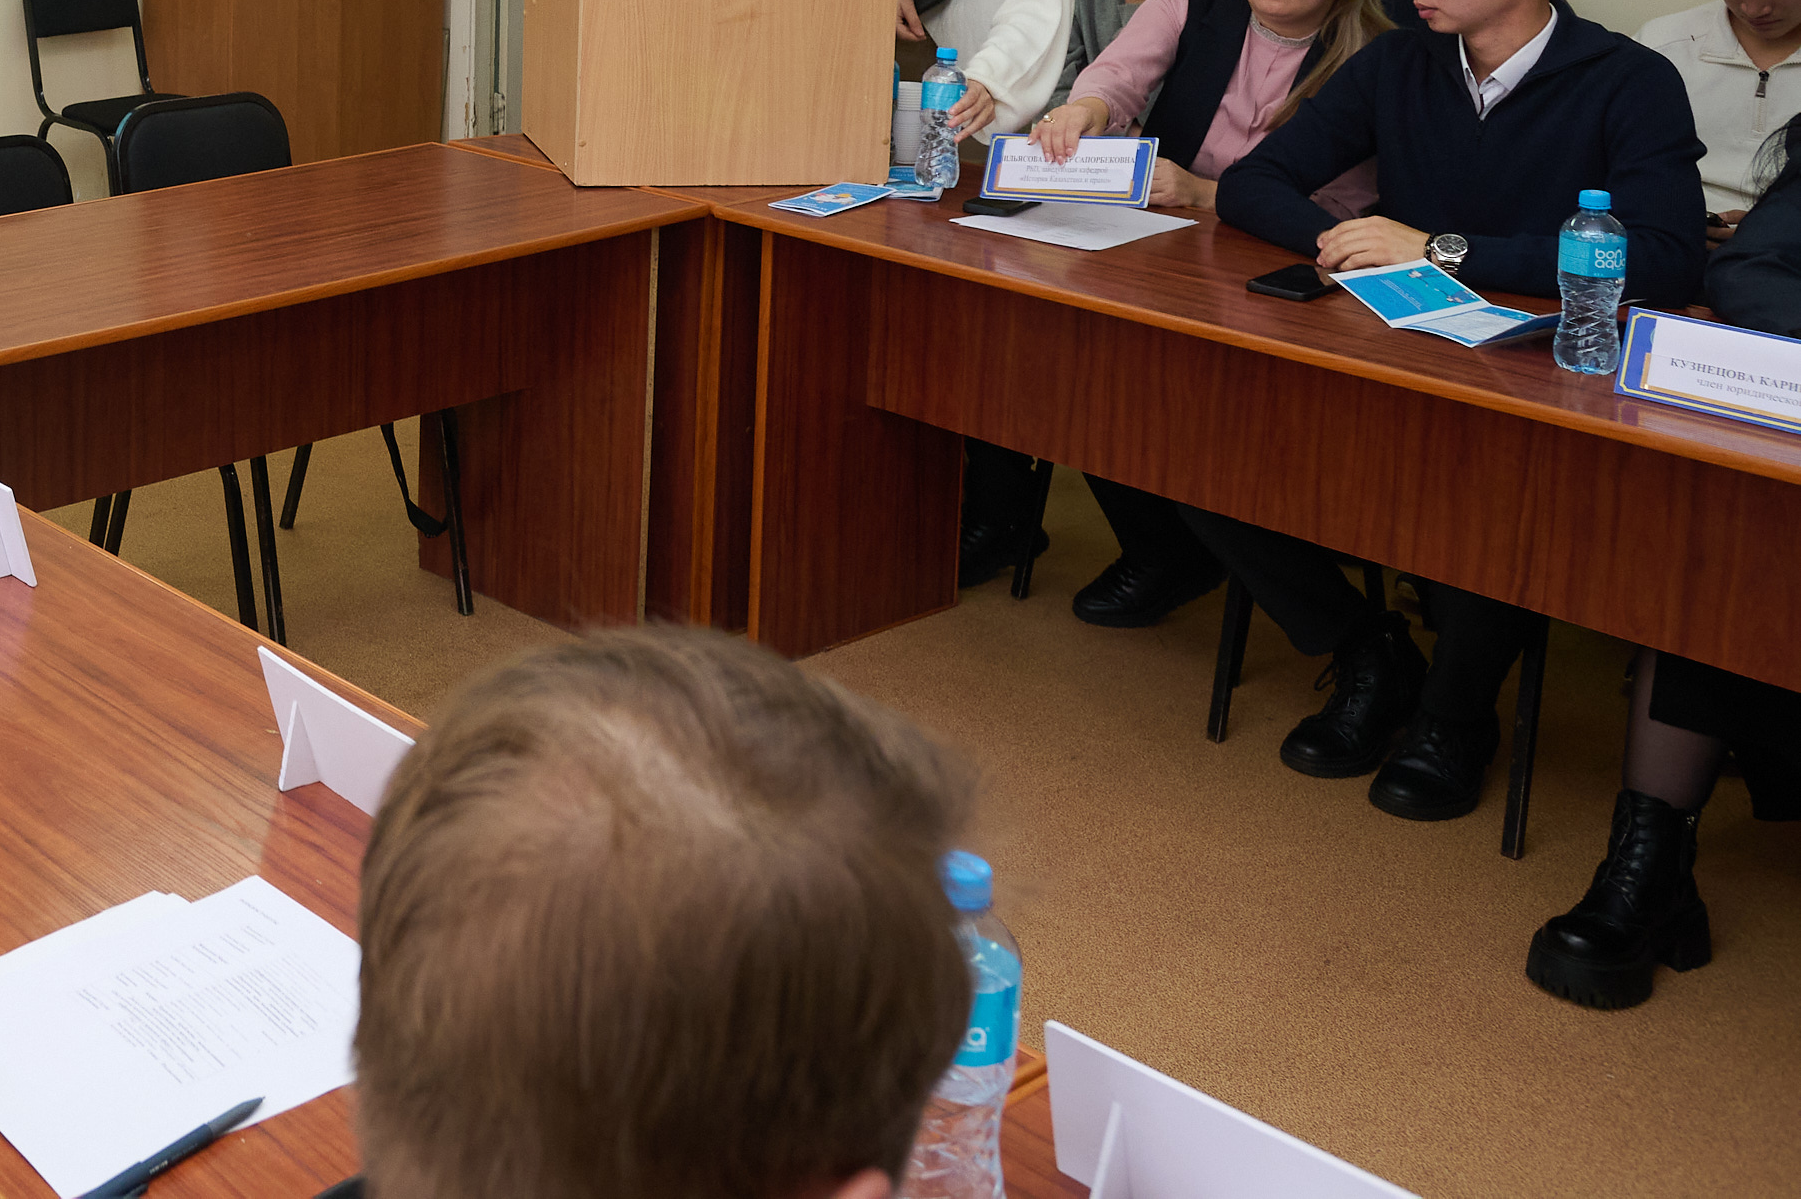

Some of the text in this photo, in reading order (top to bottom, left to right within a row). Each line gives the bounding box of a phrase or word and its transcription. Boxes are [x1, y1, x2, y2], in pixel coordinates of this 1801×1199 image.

[1003, 154, 1043, 163] ИЛЬЯСОВА
[1670, 357, 1801, 394] КУЗНЕЦОВА КАРИ
[1697, 378, 1801, 407] член юридическо
